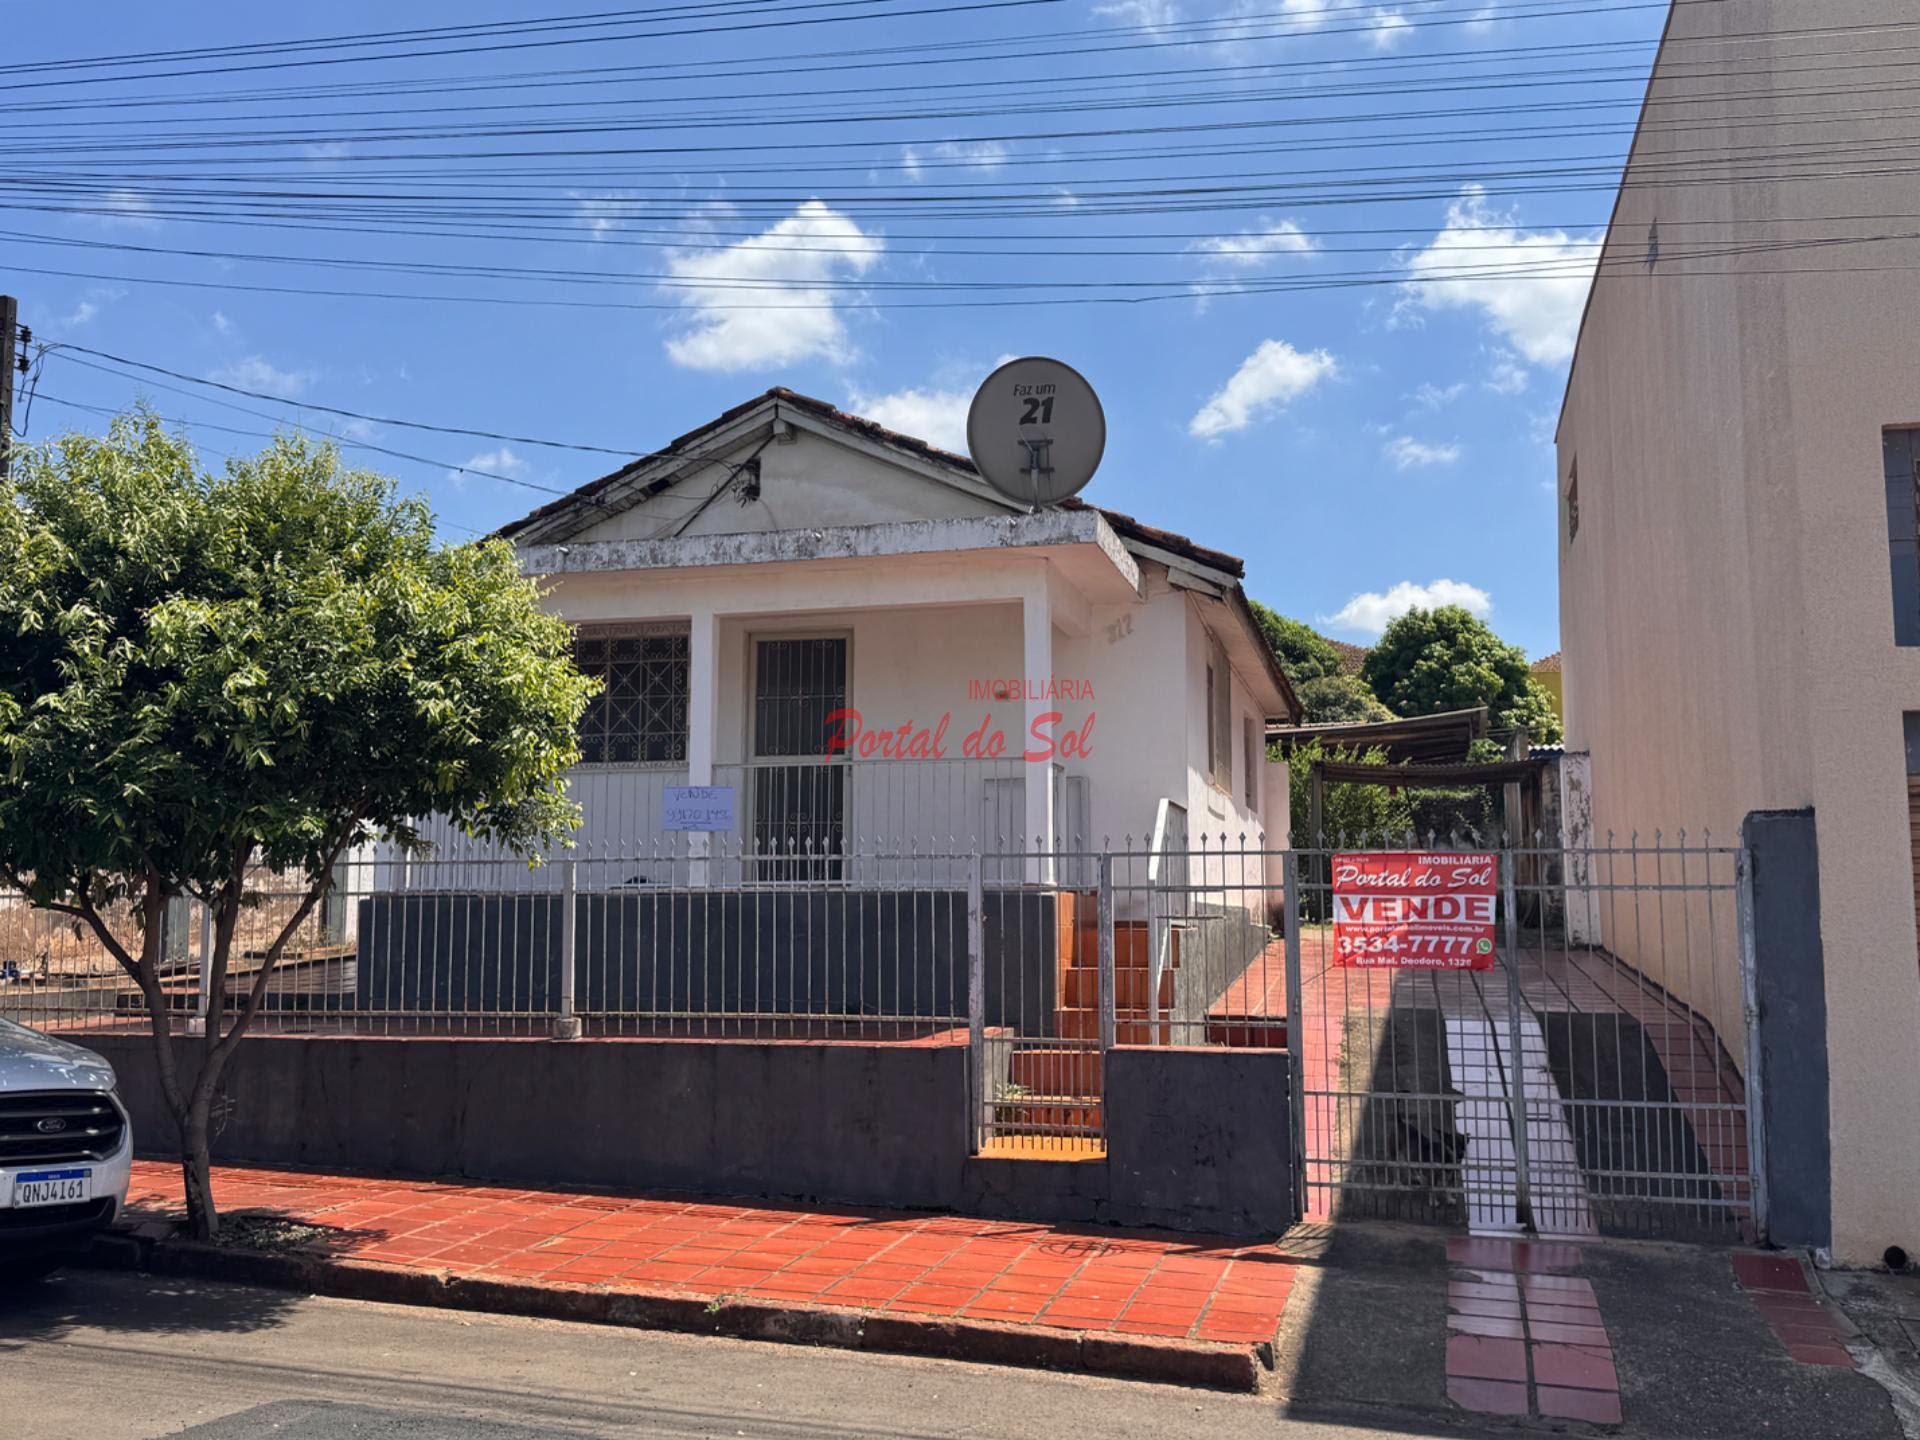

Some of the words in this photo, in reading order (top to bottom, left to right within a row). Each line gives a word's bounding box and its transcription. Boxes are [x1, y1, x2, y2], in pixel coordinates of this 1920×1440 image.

[1013, 384, 1032, 396] Faz
[1035, 384, 1056, 395] um
[1019, 396, 1055, 425] 21
[1336, 865, 1411, 888] Portal
[1415, 868, 1442, 887] do
[1447, 867, 1492, 888] Sol
[1340, 897, 1491, 922] VENDE
[1337, 935, 1473, 954] 3534-7777
[1356, 956, 1375, 965] Rua
[1378, 956, 1397, 965] Mal.
[1401, 956, 1445, 967] Deodoro,
[22, 1180, 83, 1204] QNJ4I61
